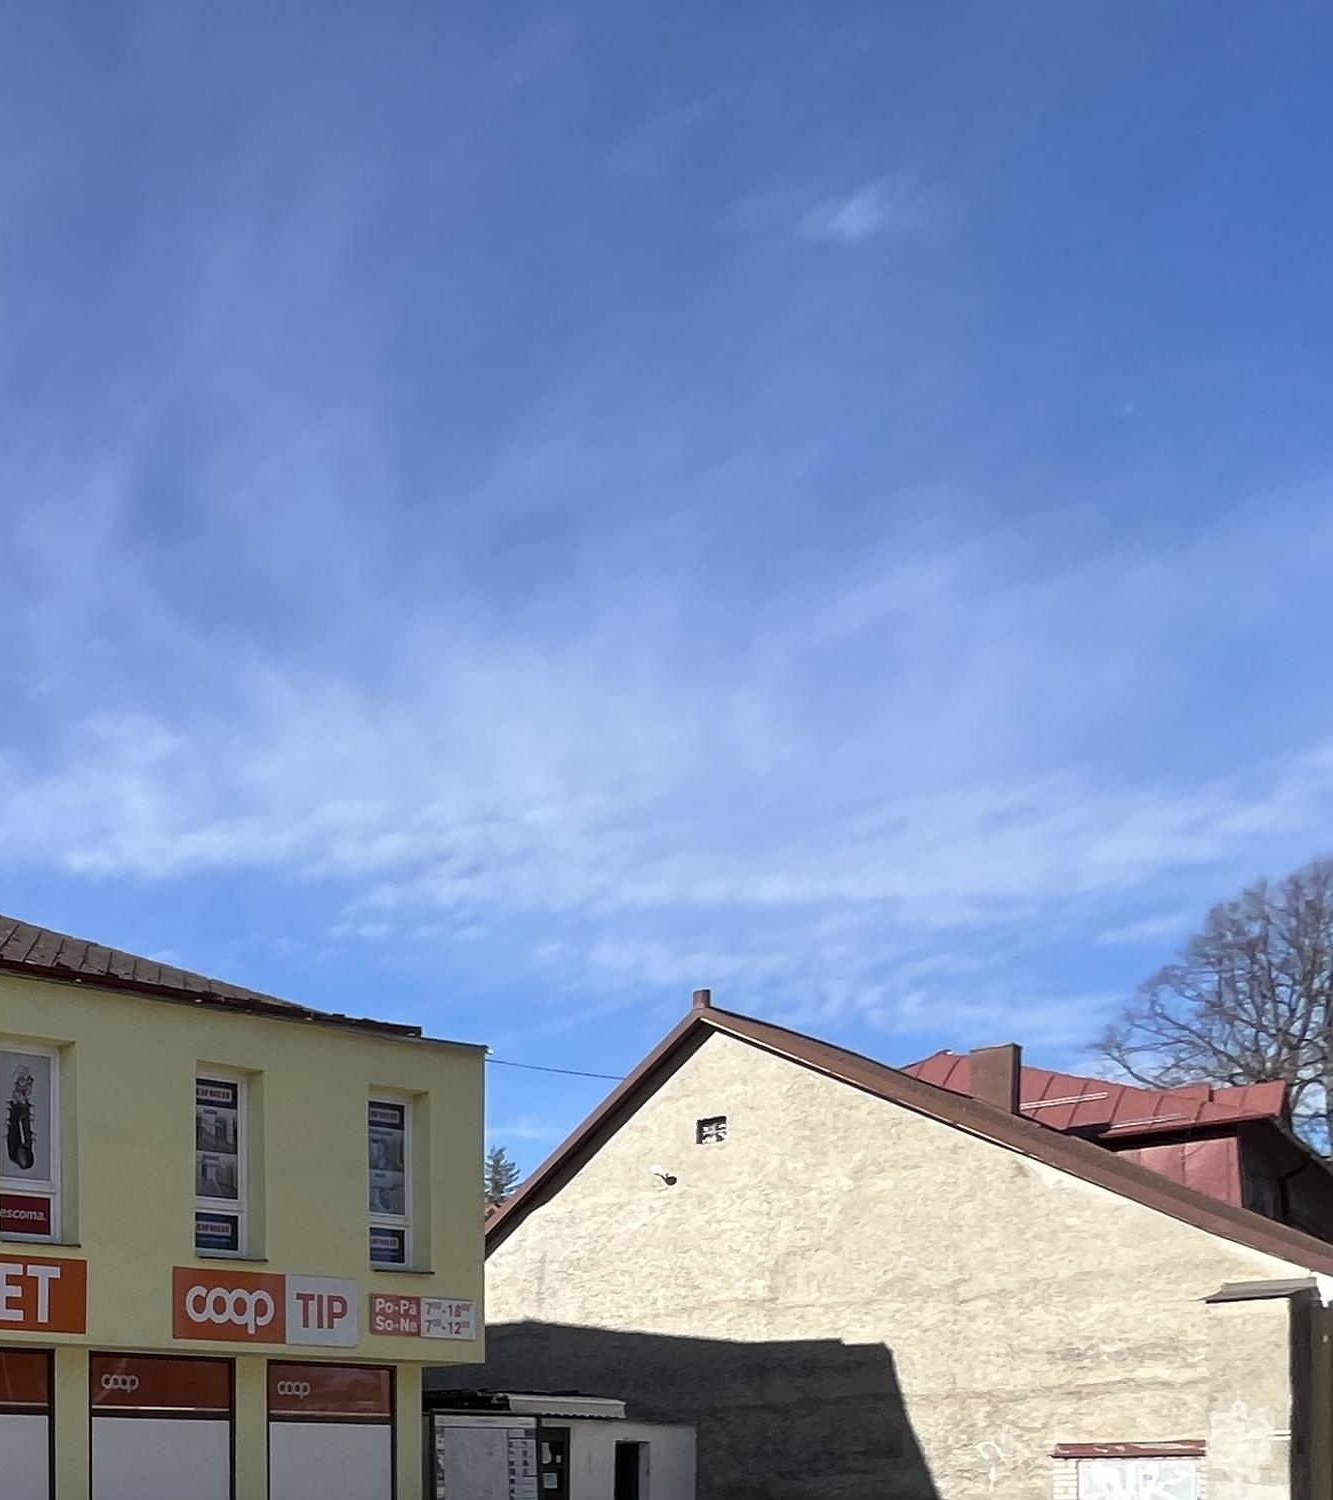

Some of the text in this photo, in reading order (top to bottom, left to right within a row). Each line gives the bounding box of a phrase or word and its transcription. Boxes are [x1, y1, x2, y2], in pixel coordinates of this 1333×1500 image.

[185, 1285, 349, 1334] coop TIP
[375, 1298, 418, 1316] Po-Pá
[375, 1315, 419, 1332] So-Ne
[101, 1374, 139, 1393] coop
[277, 1380, 311, 1400] coop
